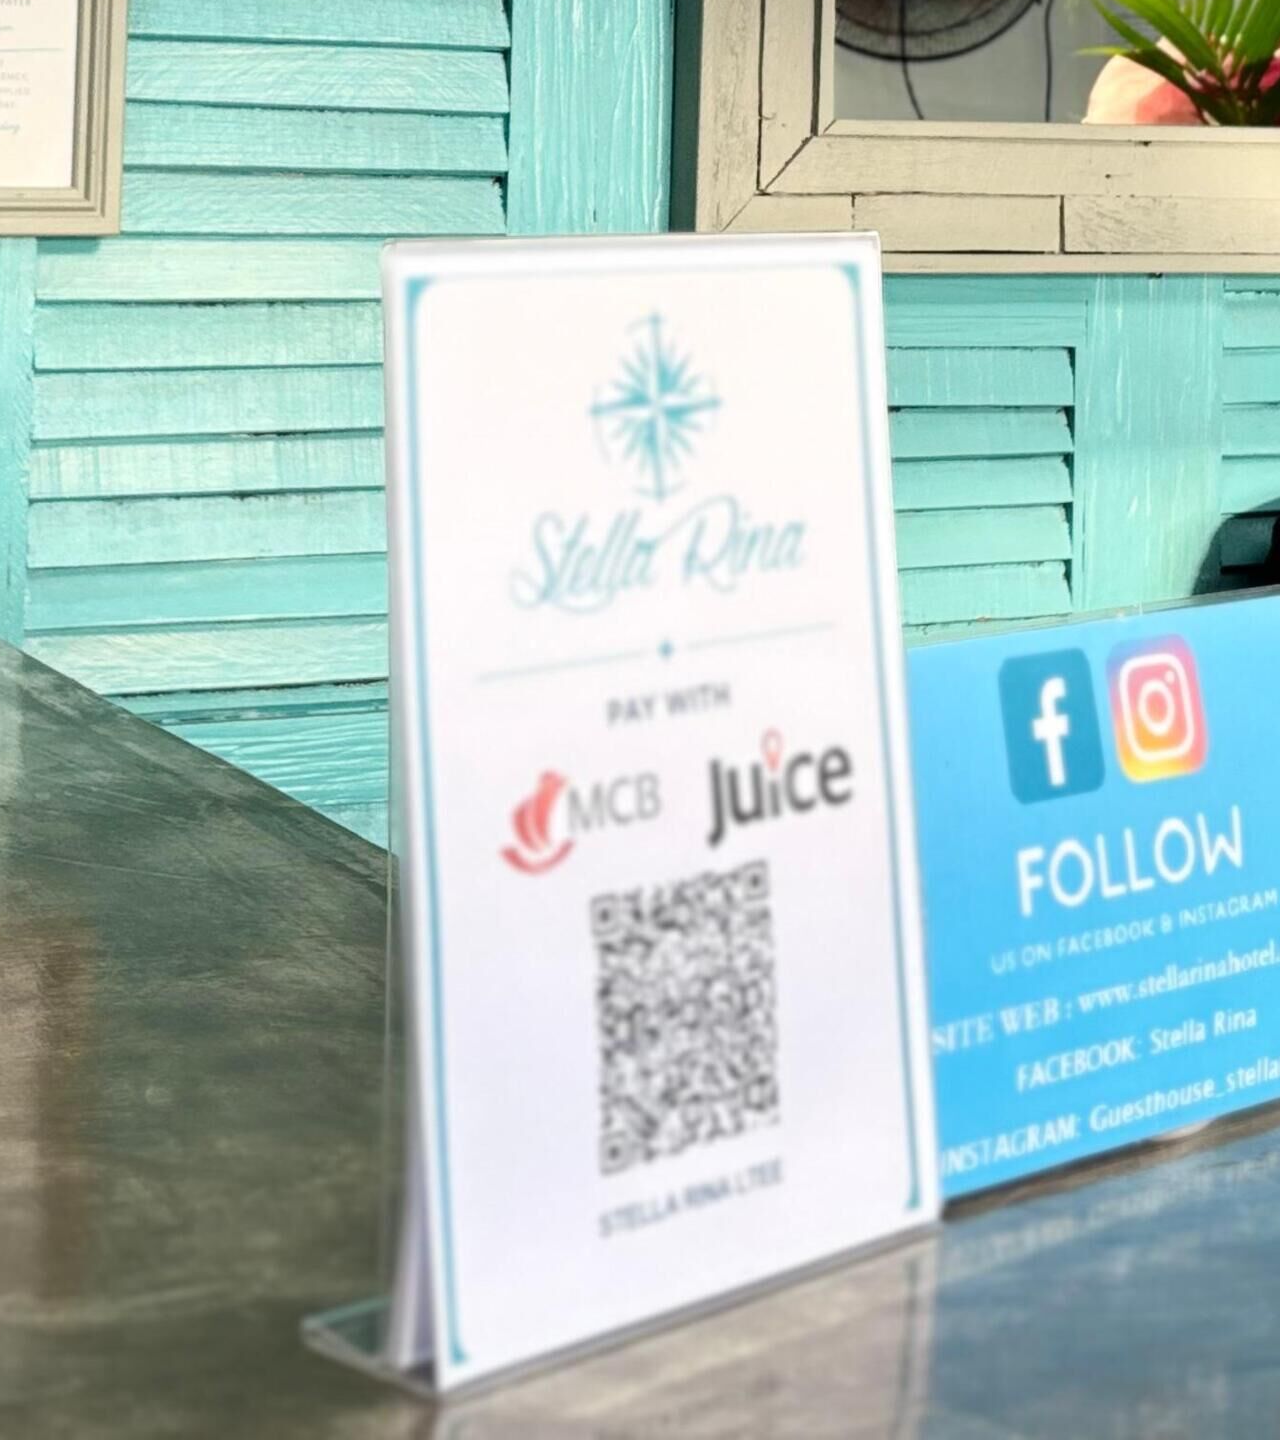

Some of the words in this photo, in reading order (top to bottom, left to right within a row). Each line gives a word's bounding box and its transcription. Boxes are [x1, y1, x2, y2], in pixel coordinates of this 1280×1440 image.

[509, 506, 661, 616] Stella
[663, 494, 807, 593] Rina
[606, 698, 656, 729] PAY
[666, 682, 732, 717] WITH
[566, 772, 662, 835] MCB
[1017, 803, 1245, 918] FOLLOW
[991, 950, 1017, 976] US
[1021, 942, 1052, 967] ON
[1057, 918, 1156, 959] FACEBOOK
[1178, 888, 1280, 929] INSTAGRAM
[931, 1013, 995, 1057] SITE
[1000, 997, 1061, 1036] WEB
[1017, 1039, 1143, 1094] FACEBOOK:
[1149, 1020, 1207, 1055] Stella
[1214, 1006, 1258, 1038] Rina
[599, 1191, 679, 1238] STELLA
[682, 1177, 731, 1208] RINA
